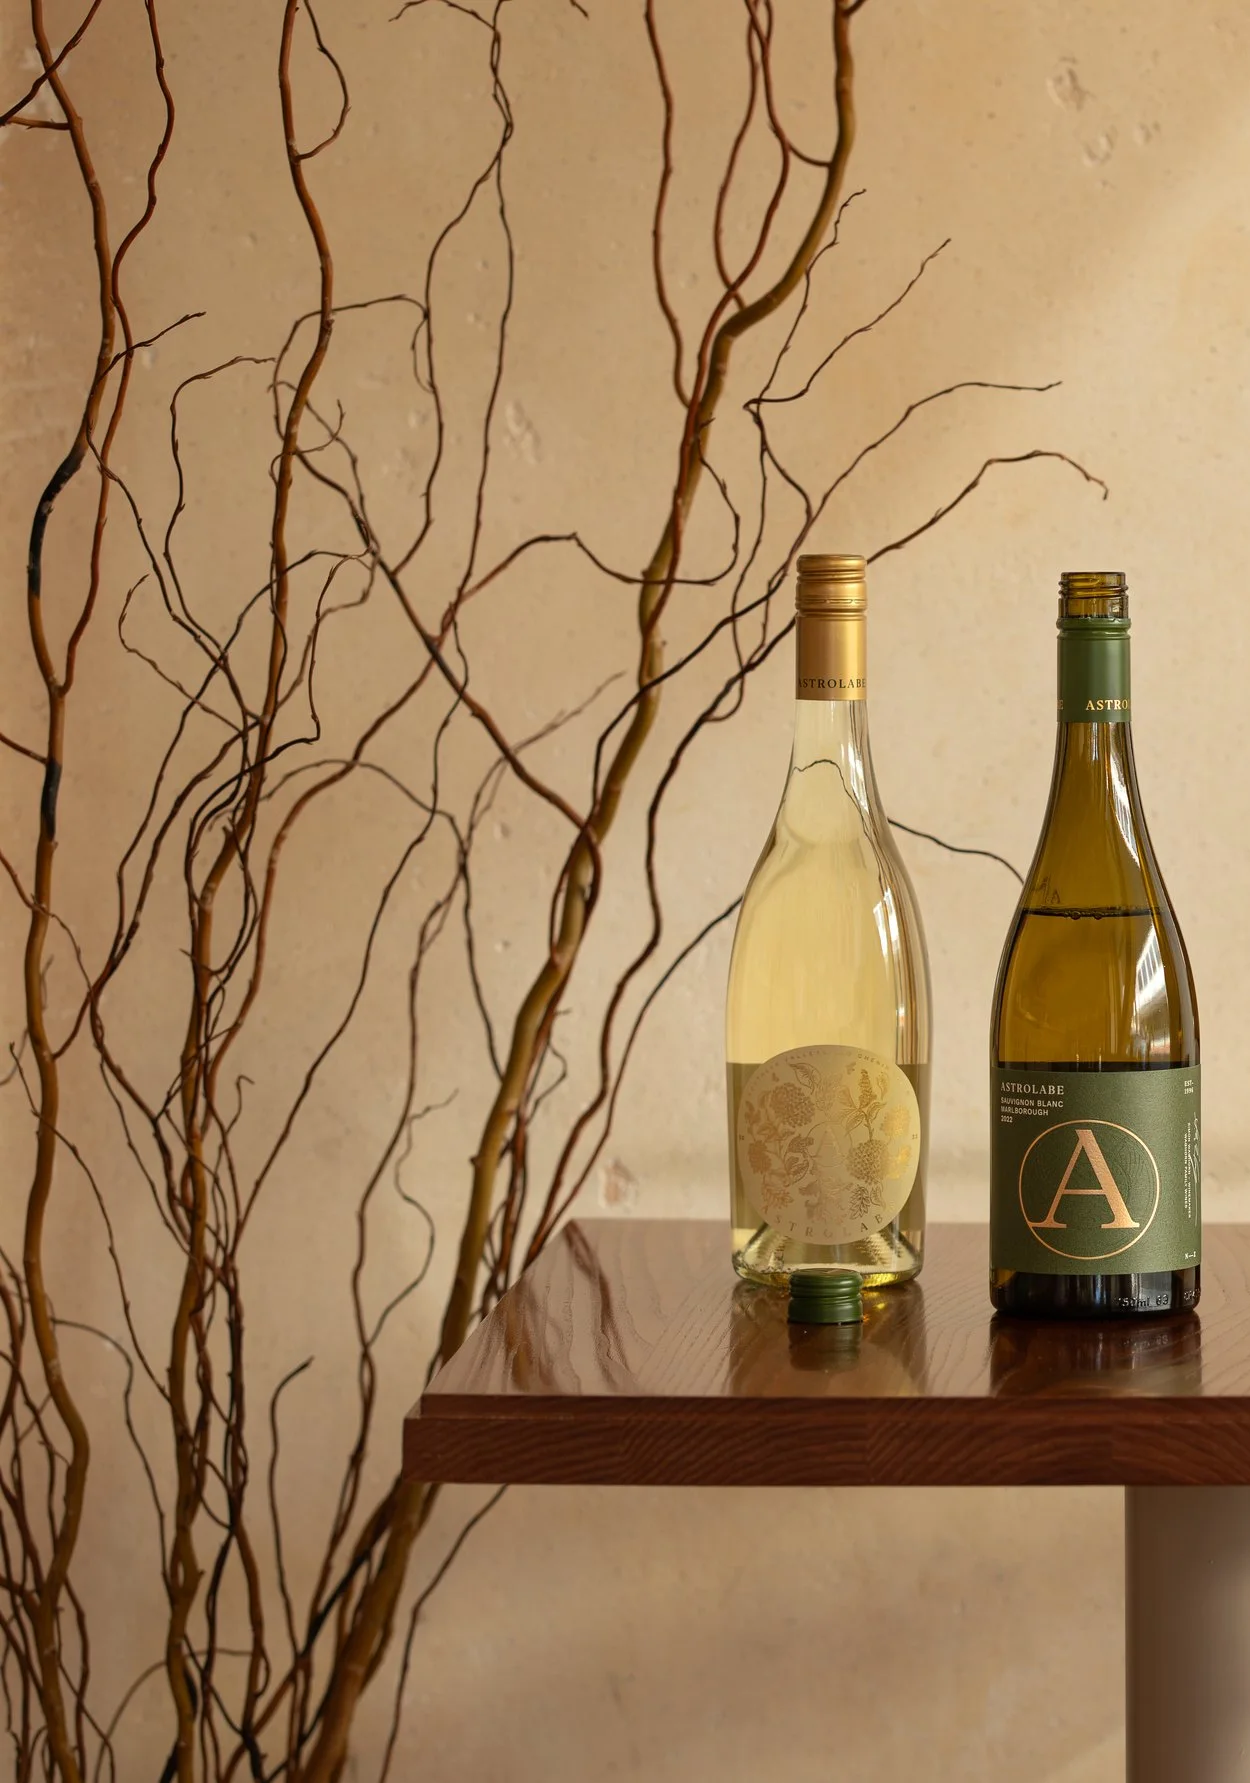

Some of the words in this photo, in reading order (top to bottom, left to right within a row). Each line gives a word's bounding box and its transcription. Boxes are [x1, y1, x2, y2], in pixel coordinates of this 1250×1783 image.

[1000, 1082, 1064, 1095] ASTROLABE
[1000, 1097, 1034, 1107] SAUVIGNON
[1037, 1100, 1064, 1108] BLANC
[1000, 1106, 1049, 1116] MARLBOROUGH
[1027, 1129, 1140, 1229] A
